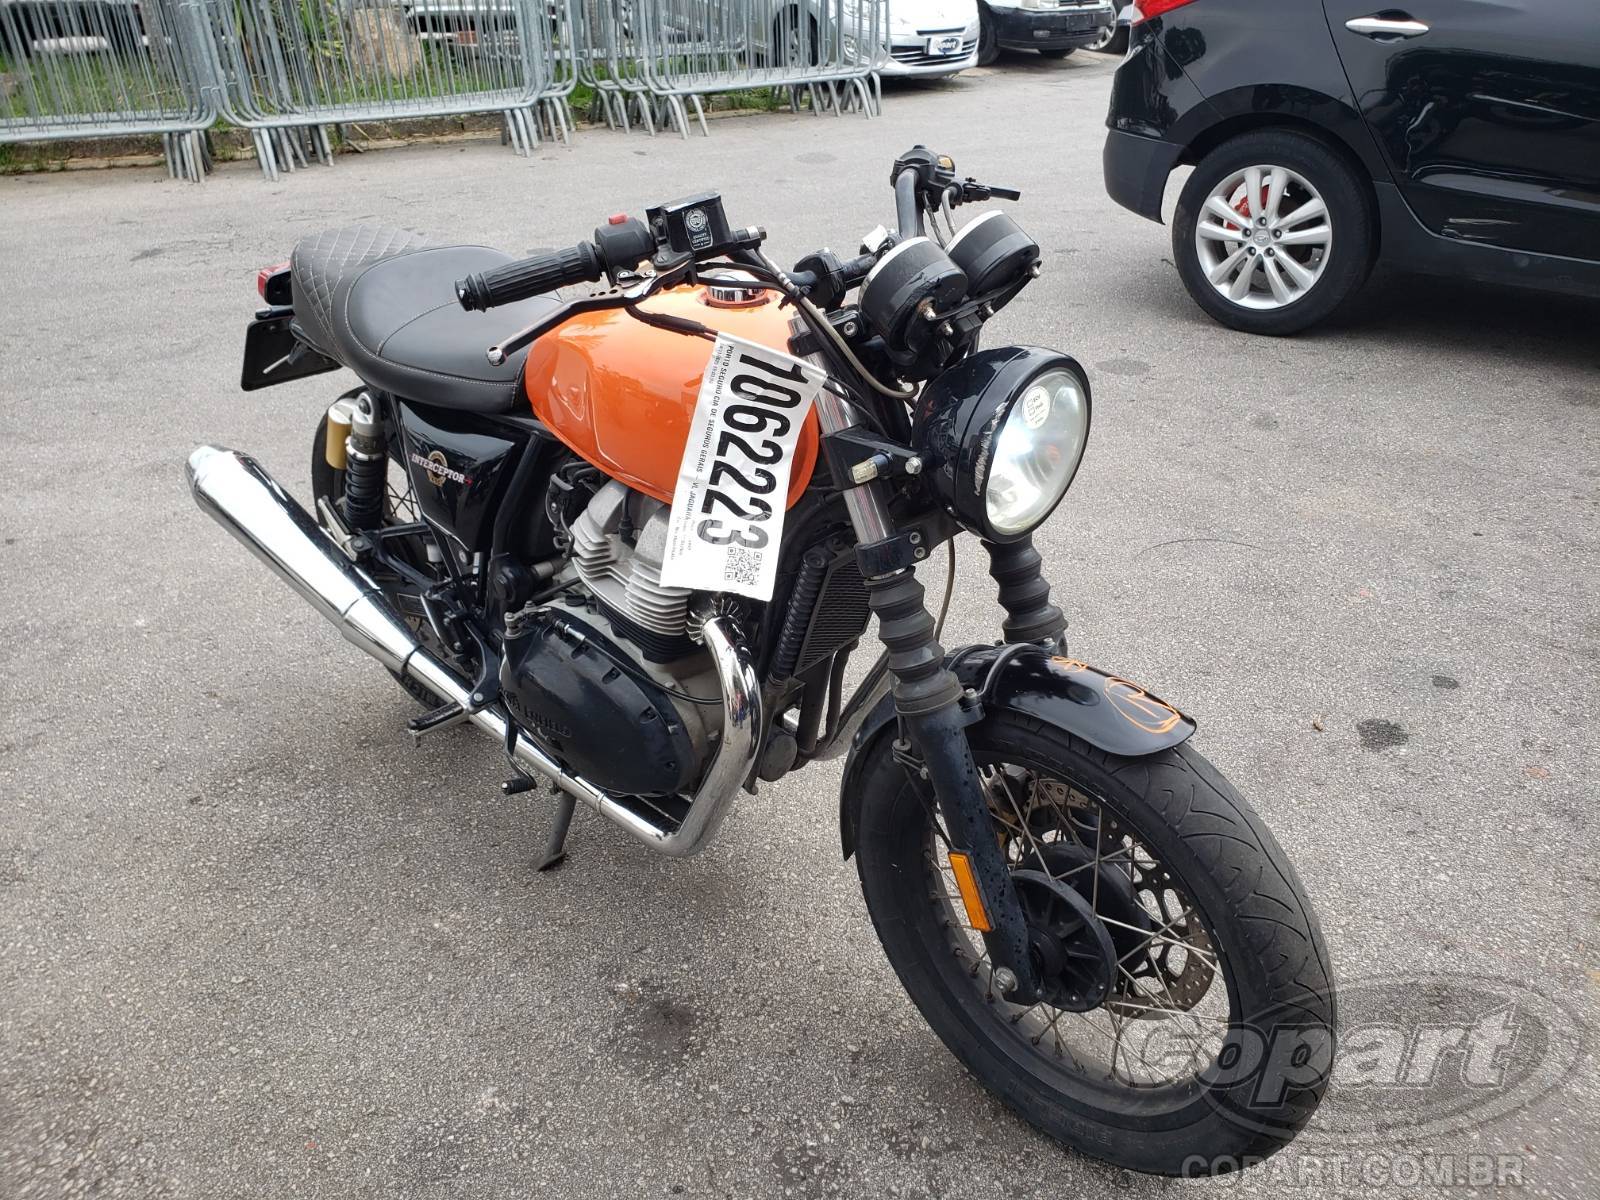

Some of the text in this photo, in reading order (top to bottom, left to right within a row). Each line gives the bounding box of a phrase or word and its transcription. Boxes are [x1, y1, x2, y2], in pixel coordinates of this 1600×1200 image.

[710, 407, 718, 418] DE
[712, 393, 721, 407] CIA
[702, 418, 716, 449] SEGUROS
[696, 449, 707, 473] GERAIS
[697, 353, 810, 550] 1062223
[410, 453, 465, 484] INTERCEPTOR
